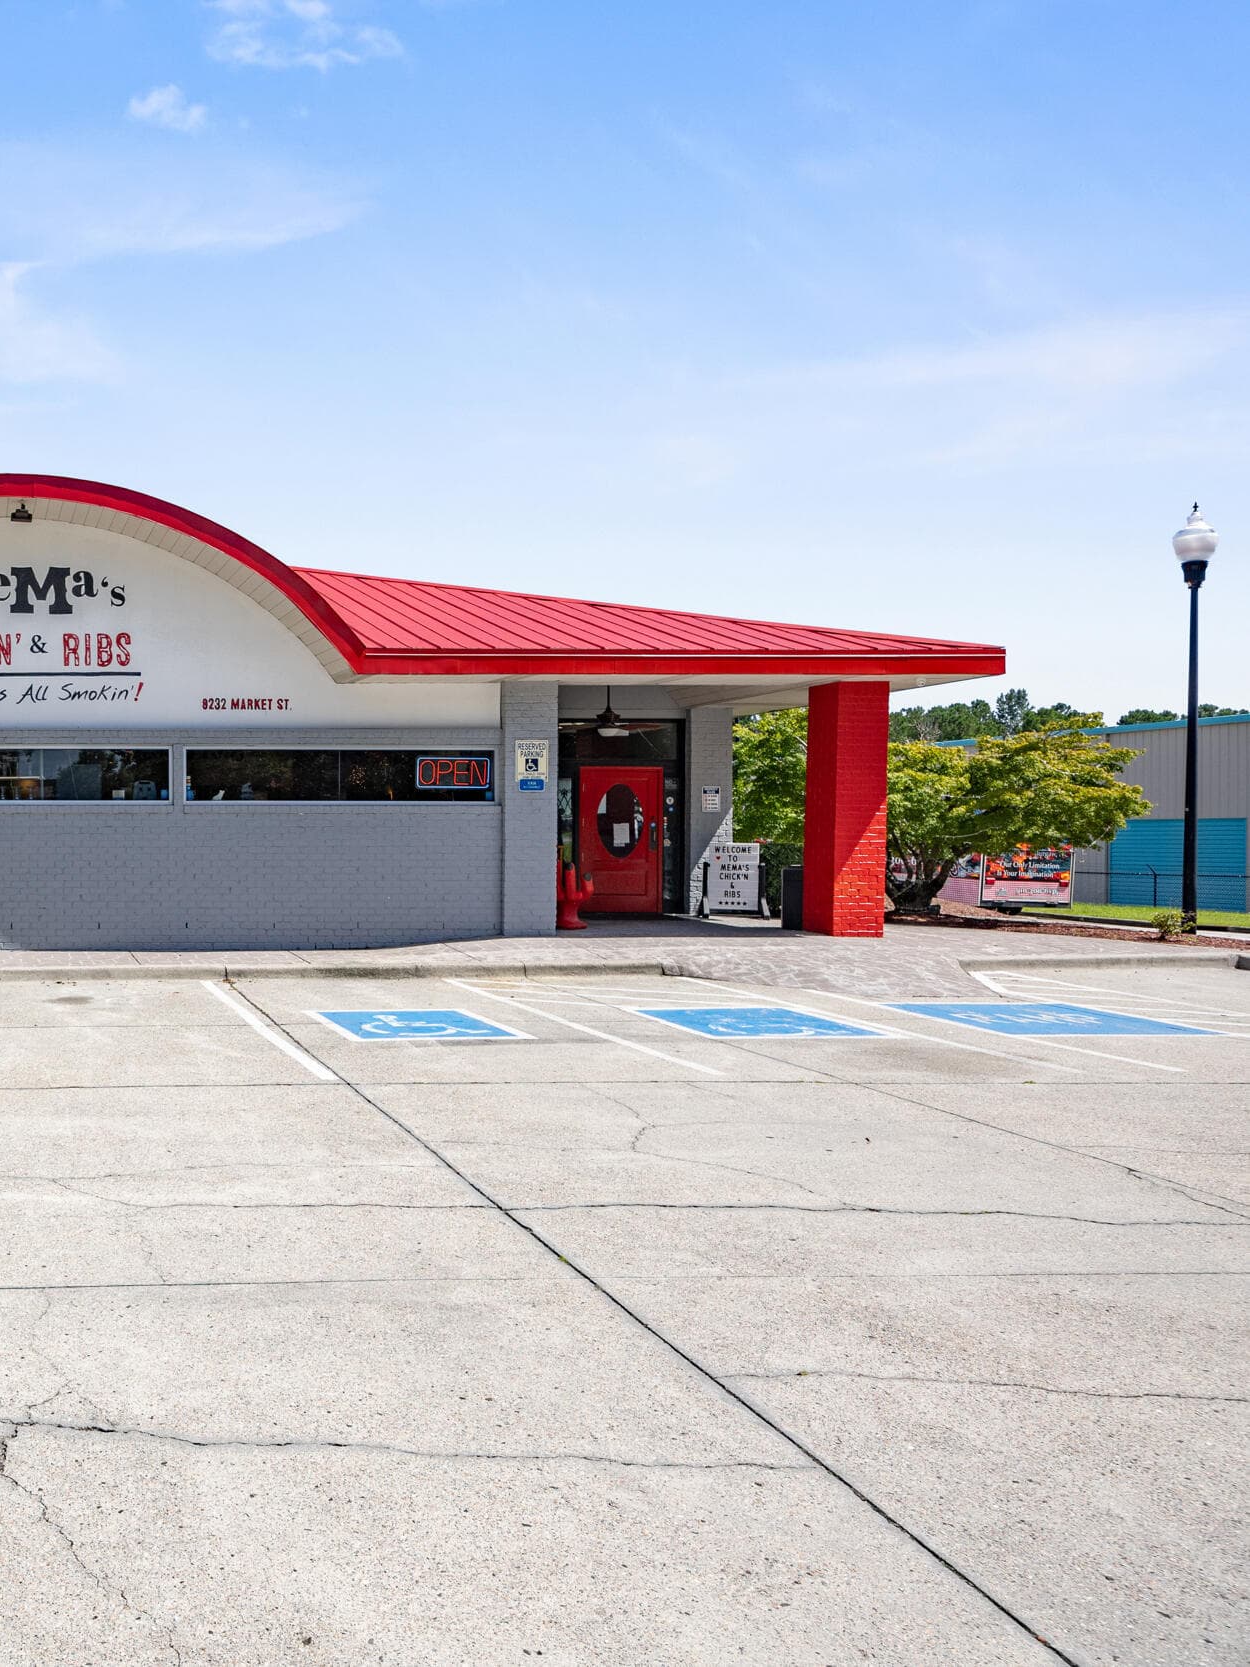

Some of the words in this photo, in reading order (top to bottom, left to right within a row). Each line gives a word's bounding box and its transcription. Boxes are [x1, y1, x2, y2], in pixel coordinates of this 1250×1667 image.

[30, 634, 48, 655] &
[62, 632, 132, 667] RIBS
[16, 683, 49, 704] All
[230, 698, 273, 711] MARKET
[276, 698, 293, 711] ST.
[419, 760, 487, 786] OPEN
[714, 846, 752, 854] WELCOME
[720, 864, 750, 872] MEMA'S
[719, 872, 749, 880] CHICK'N
[724, 890, 741, 898] RIBS
